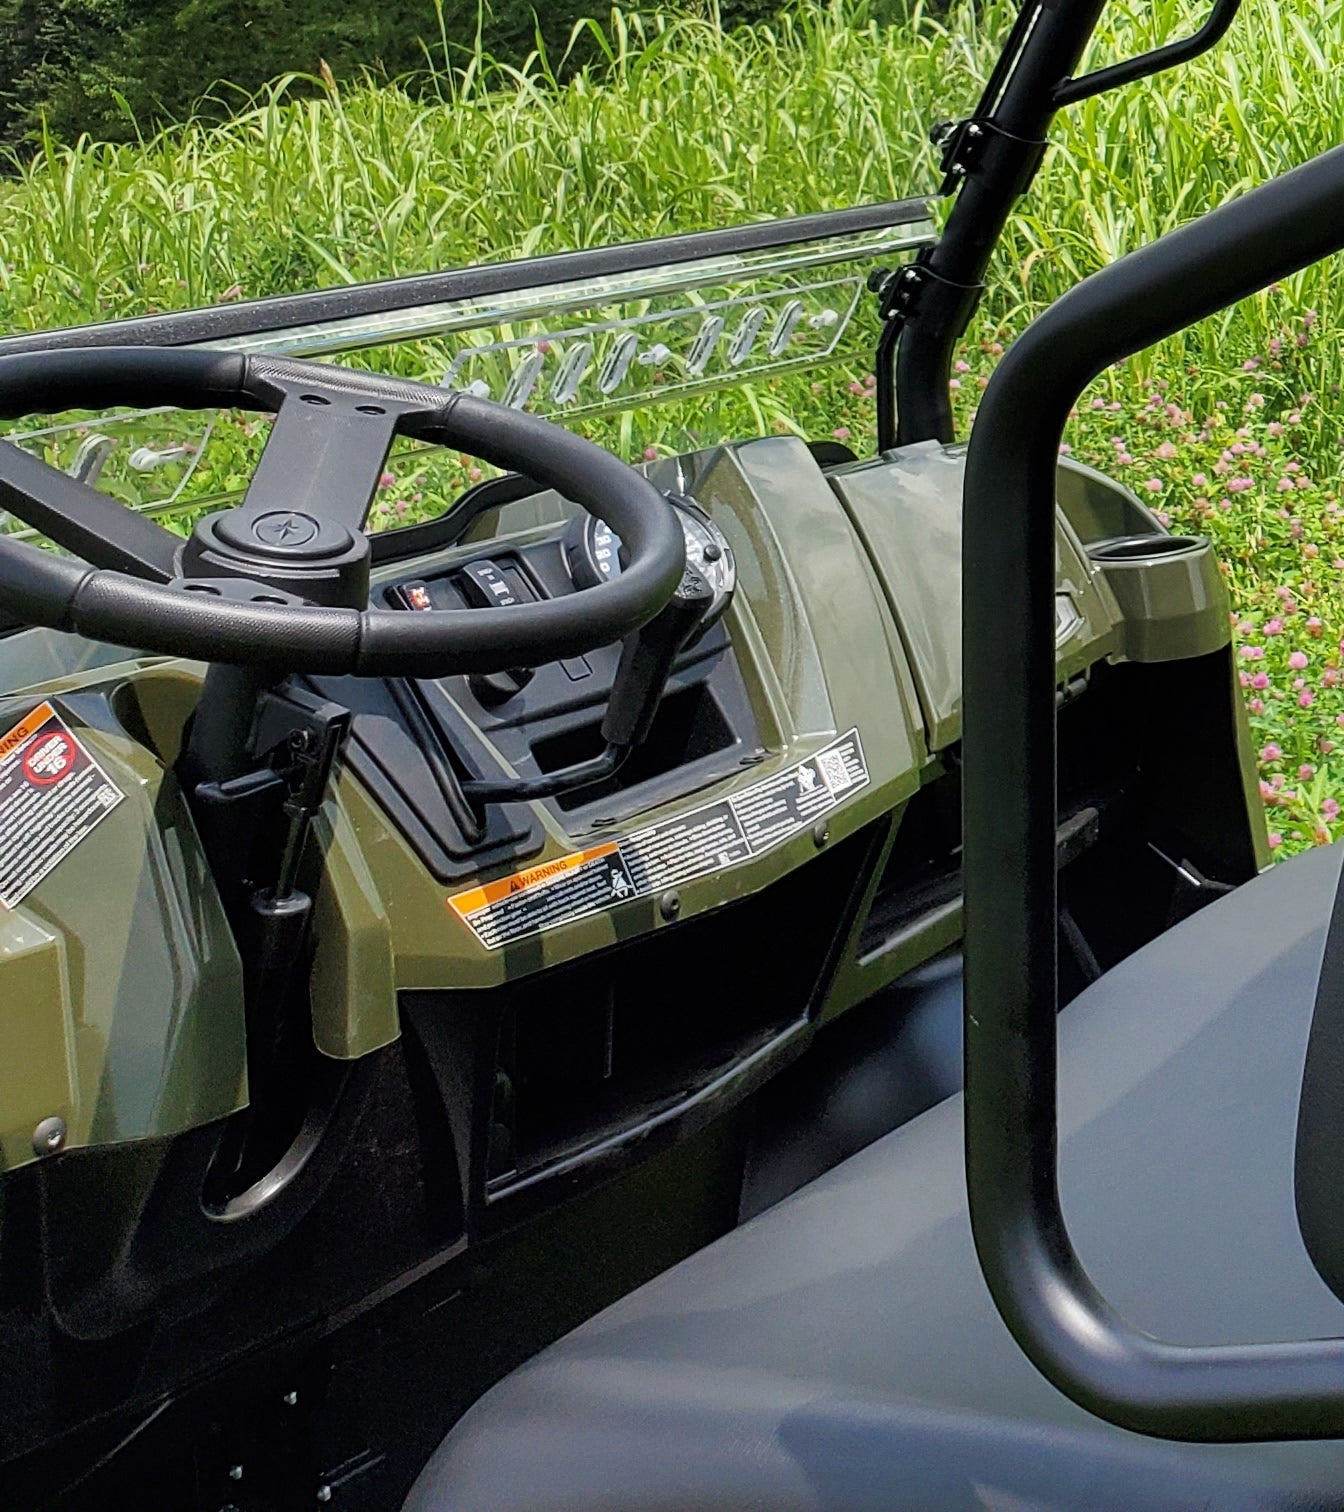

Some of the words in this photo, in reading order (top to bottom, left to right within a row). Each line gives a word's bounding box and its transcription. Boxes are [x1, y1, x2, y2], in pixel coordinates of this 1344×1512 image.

[28, 736, 63, 768] DRIVER
[33, 743, 68, 773] UNDER
[46, 756, 67, 775] 16
[519, 861, 567, 886] WARNING
